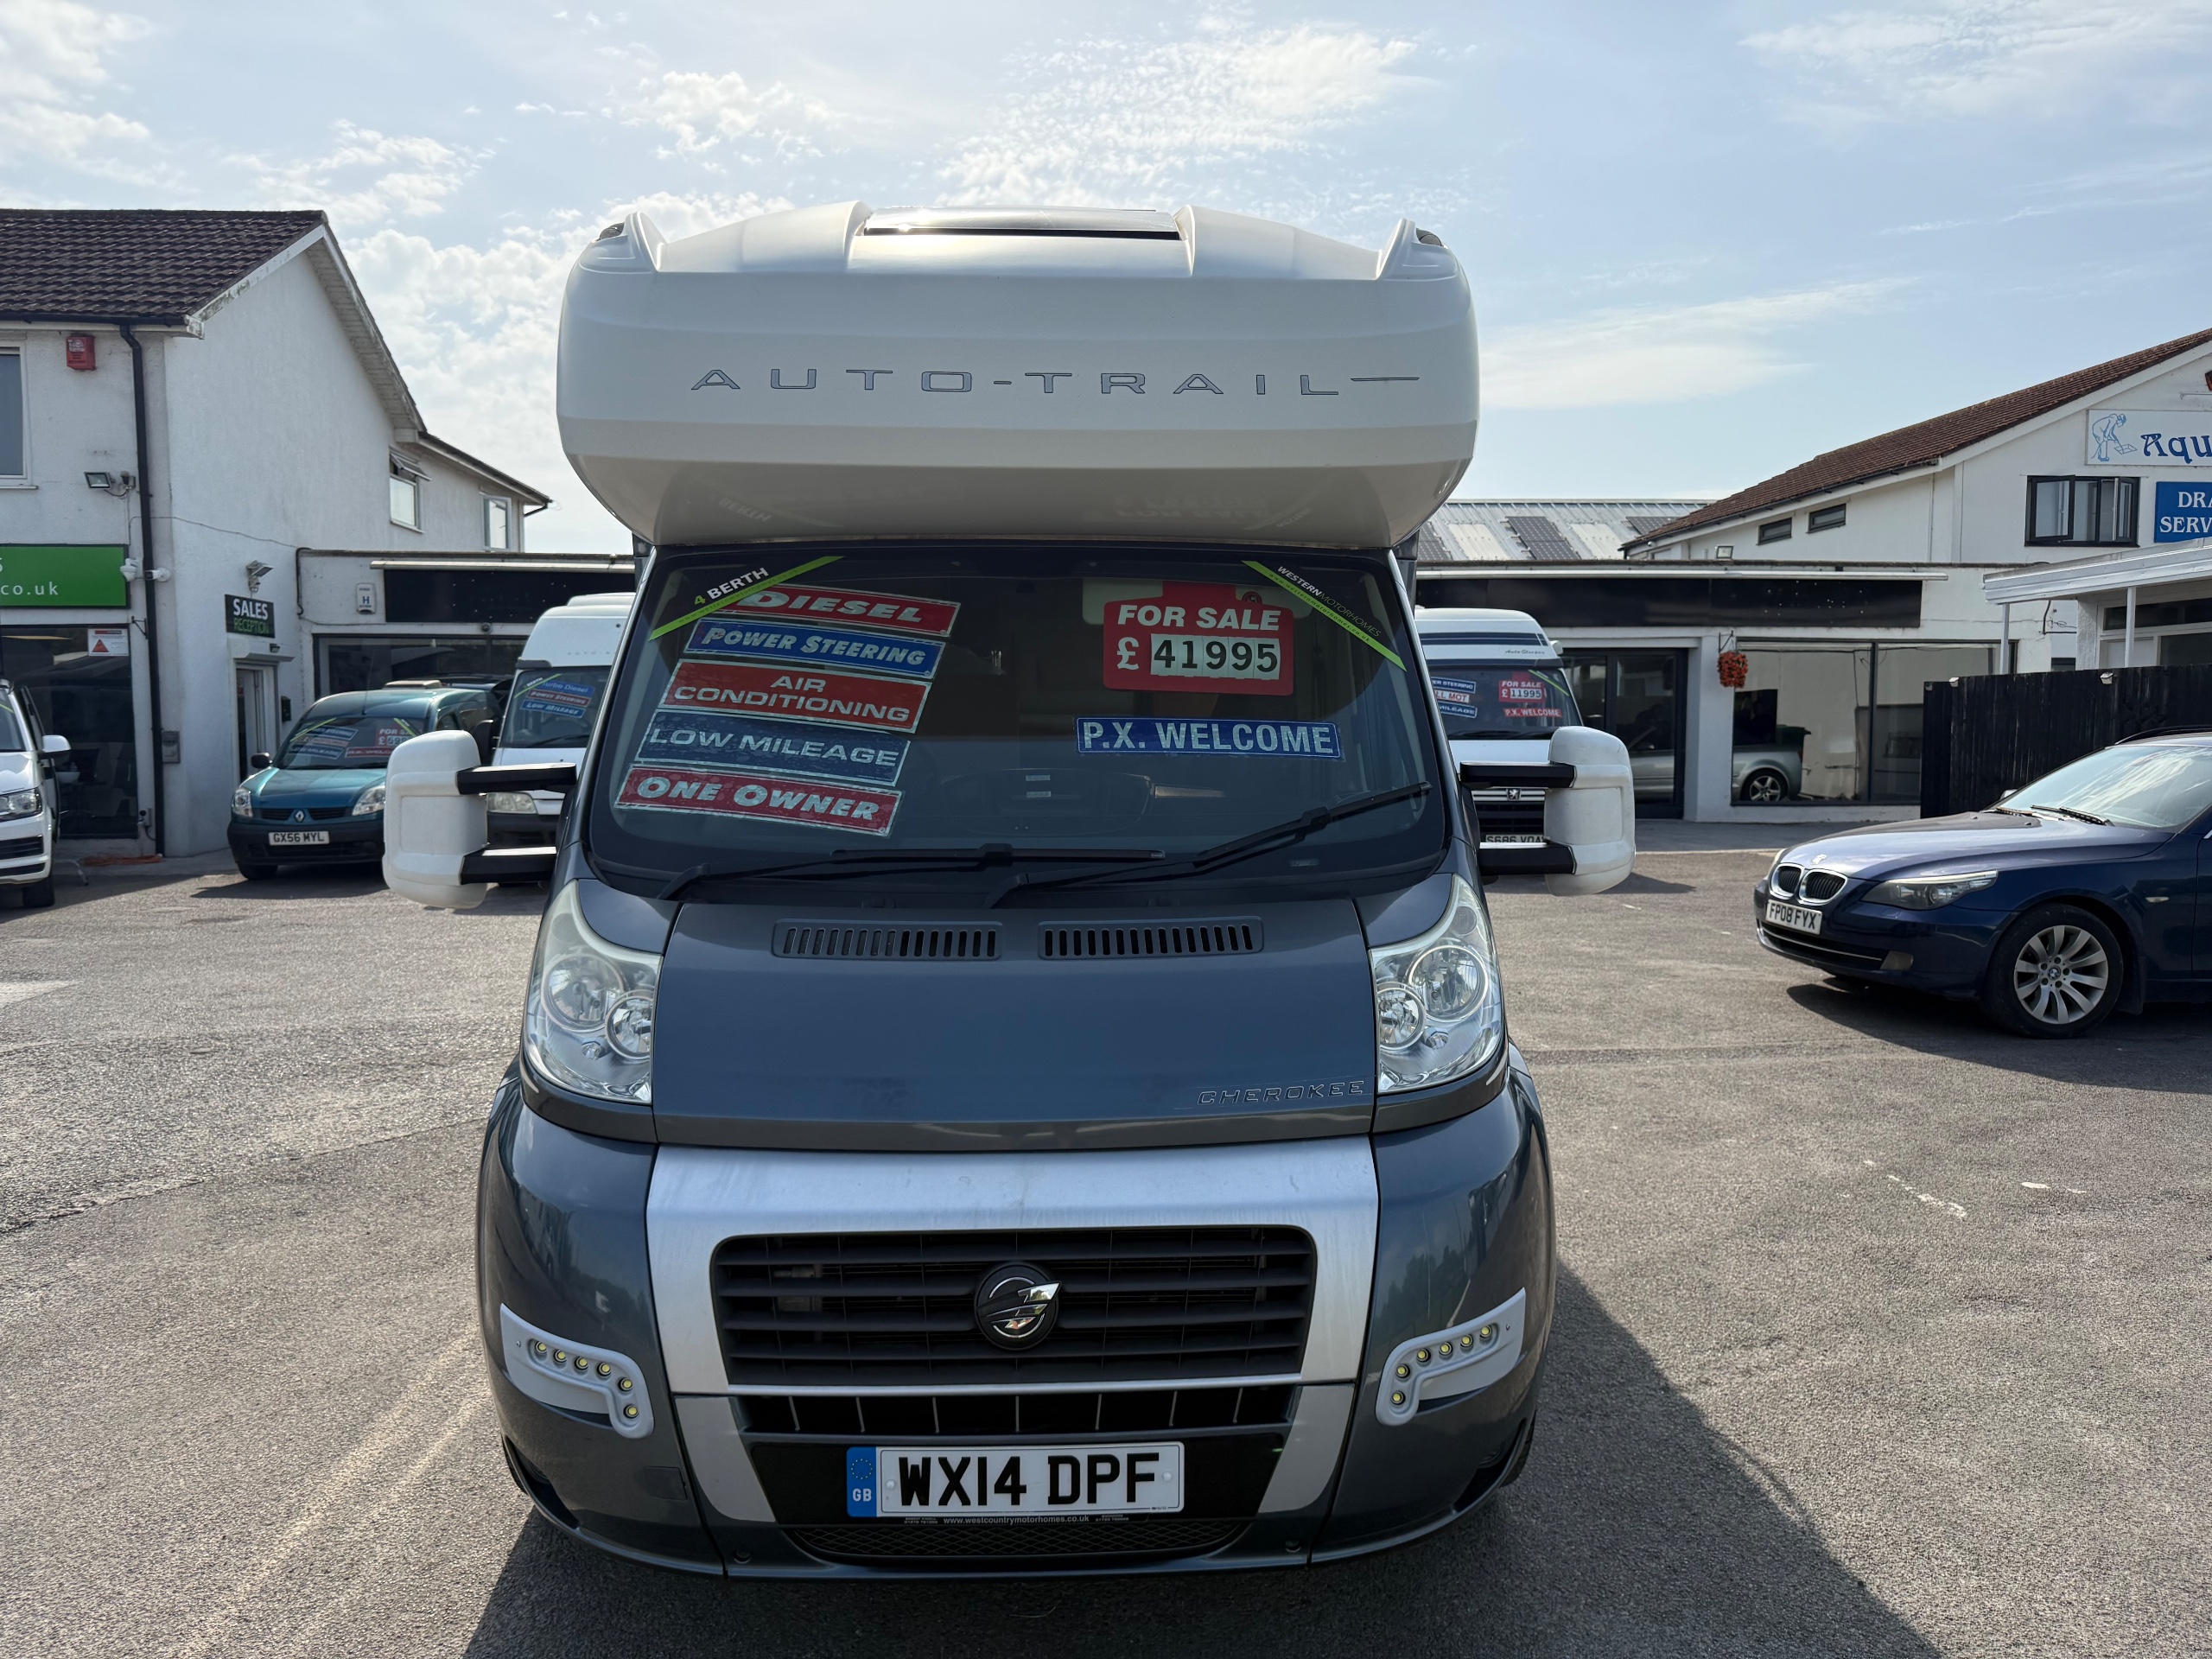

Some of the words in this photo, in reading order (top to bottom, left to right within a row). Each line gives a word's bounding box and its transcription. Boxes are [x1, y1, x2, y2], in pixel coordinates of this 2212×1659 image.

[690, 368, 1339, 396] AUTO-TRAIL
[2140, 433, 2212, 464] Aqu
[2160, 517, 2212, 533] SERV
[694, 594, 707, 606] 4
[707, 567, 770, 600] BERTH
[233, 598, 269, 620] SALES
[736, 590, 923, 623] DIESEL
[1117, 604, 1185, 627] FOR
[1196, 607, 1281, 631] SALE
[233, 617, 270, 635] RECEPTION
[702, 627, 793, 651] POWER
[800, 635, 926, 666] STEERING
[1116, 637, 1140, 671] £
[1154, 639, 1280, 673] 41995
[564, 683, 589, 693] Diesel
[771, 676, 827, 693] AIR
[1502, 689, 1508, 697] £
[1511, 690, 1541, 698] 11995
[545, 705, 580, 715] MILEAGE
[555, 695, 586, 703] STEERING
[674, 685, 910, 722] CONDITIONING
[649, 728, 734, 749] LOW
[738, 734, 899, 768] MILEAGE
[1083, 721, 1145, 749] P.X.
[1155, 722, 1333, 753] WELCOME
[637, 776, 721, 801] ONE
[734, 784, 880, 820] OWNER
[273, 832, 301, 842] GX56
[302, 832, 325, 842] MYL
[1769, 903, 1794, 923] FP08
[1794, 910, 1817, 930] FYX
[1197, 1080, 1364, 1105] CHEROKEE
[899, 1456, 1027, 1507] WX14
[1047, 1452, 1160, 1505] DPF
[852, 1488, 873, 1503] GB
[943, 1514, 1090, 1525] www.westcountrymotorhomes.co.uk
